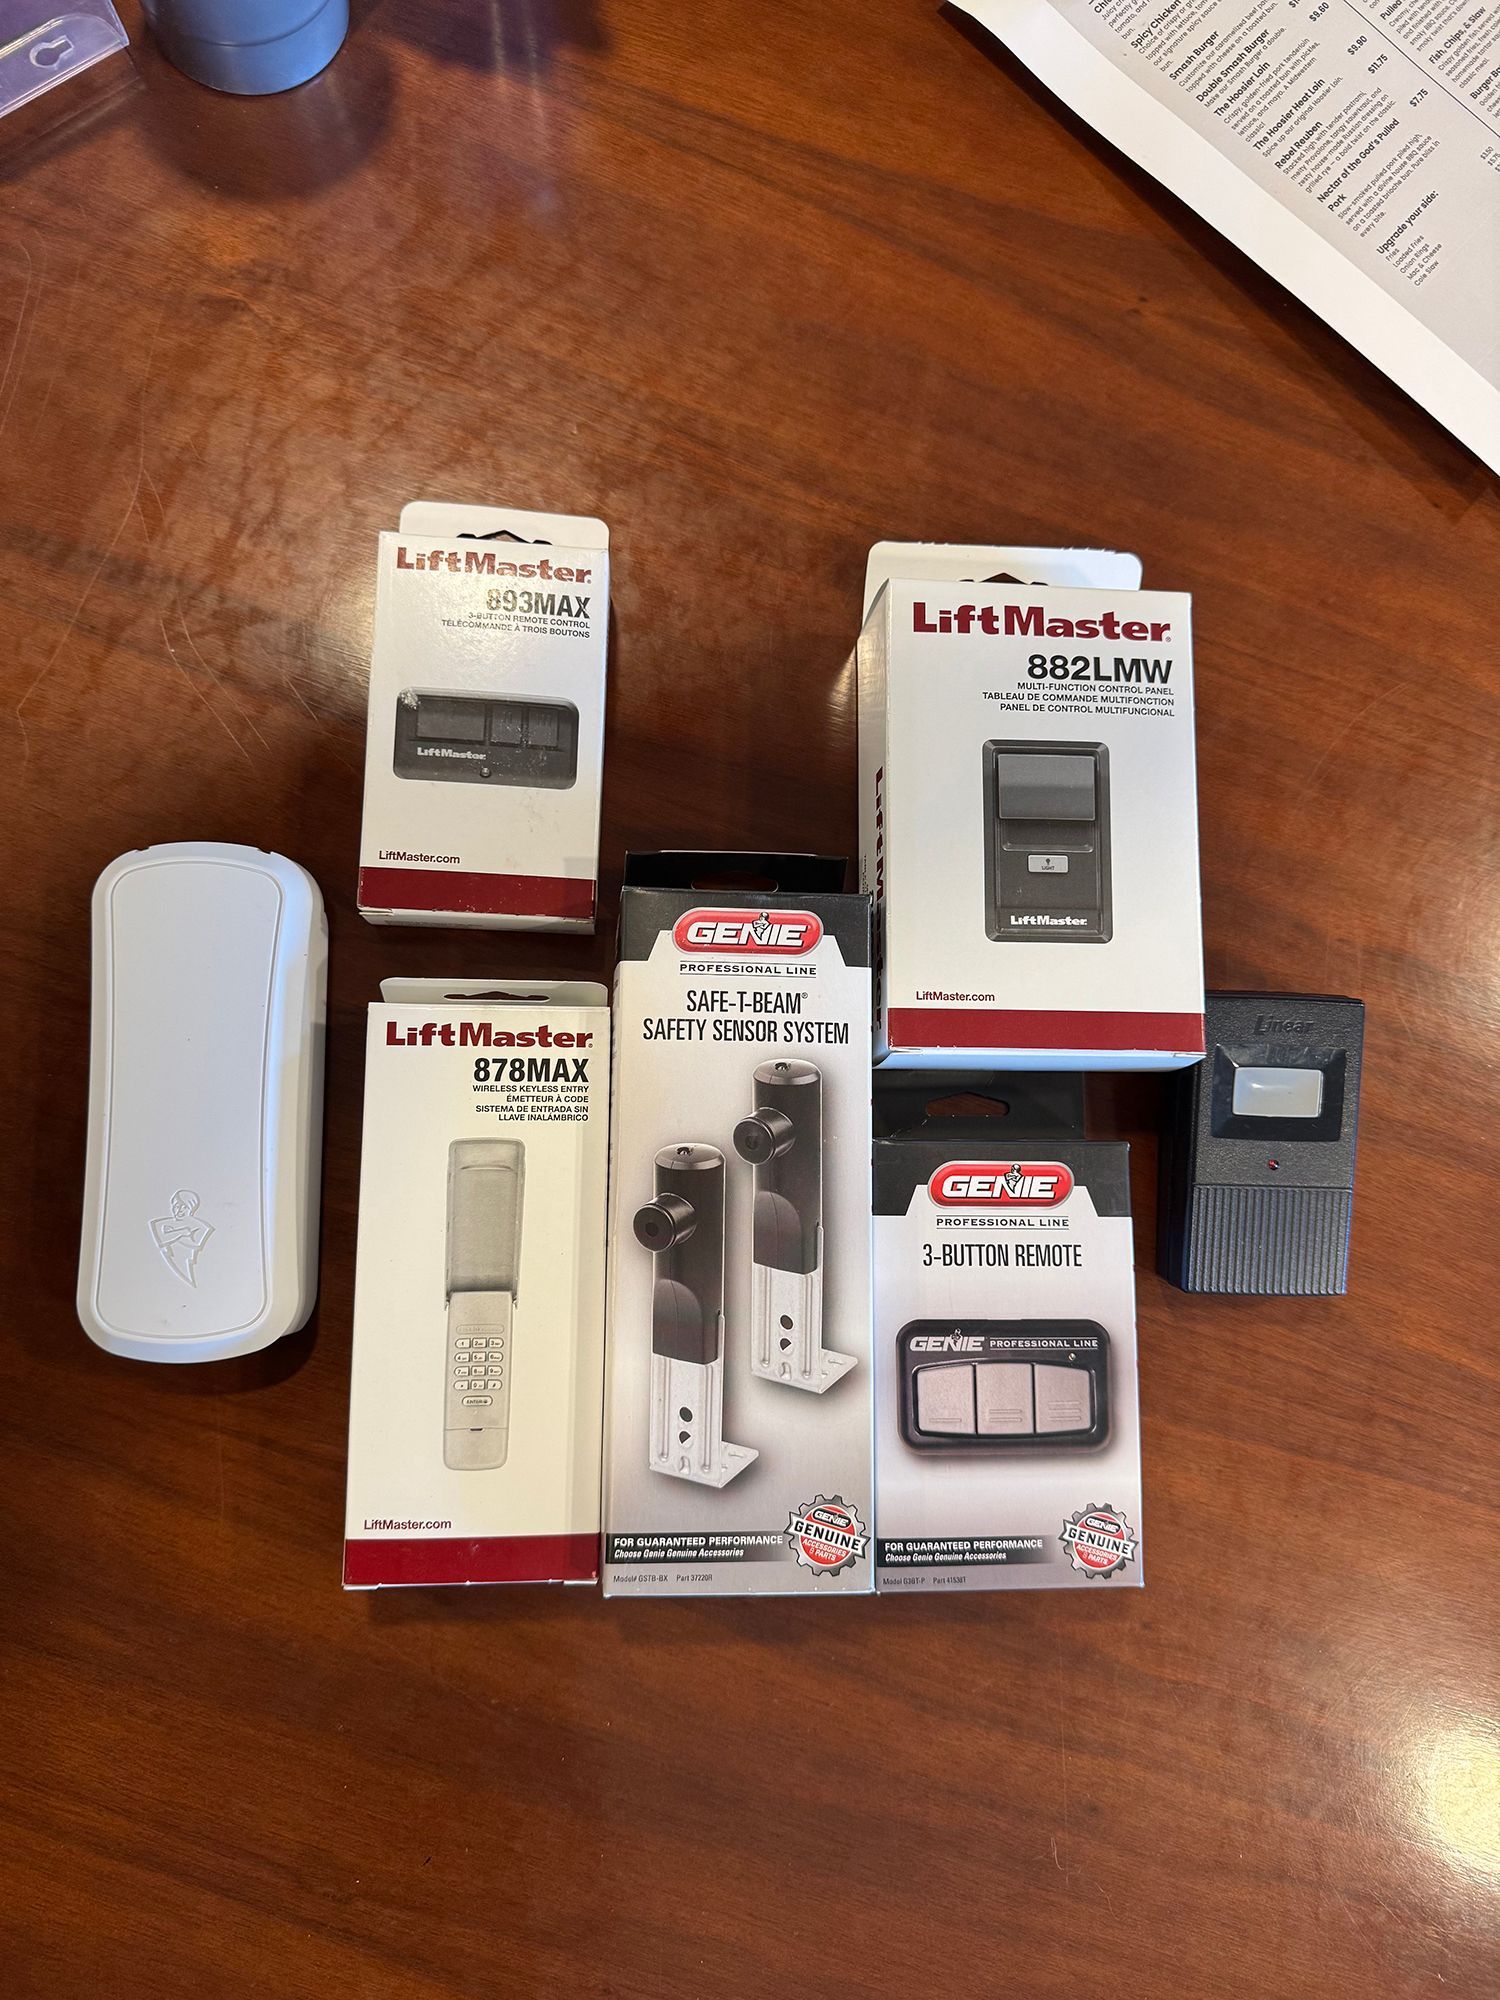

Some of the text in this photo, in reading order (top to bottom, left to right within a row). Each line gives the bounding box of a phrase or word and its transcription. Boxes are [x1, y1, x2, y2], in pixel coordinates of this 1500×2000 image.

[1308, 1, 1329, 21] $9.60
[1130, 0, 1181, 48] Spicy Chicken
[1428, 49, 1447, 64] Fish,
[1443, 29, 1466, 48] Chips,
[1467, 6, 1485, 23] Slaw
[1347, 35, 1367, 55] $9.90
[1169, 30, 1218, 80] Smash Burger
[1367, 53, 1387, 73] $11.75
[1195, 28, 1269, 102] Double Smash Burger
[1203, 93, 1220, 107] Make
[1218, 83, 1228, 94] our
[1226, 66, 1246, 85] Smash
[1243, 48, 1263, 67] Burger
[1266, 27, 1286, 45] double.
[1458, 57, 1489, 88] classic meal.
[1213, 62, 1270, 116] The Hoosier Loin
[1469, 75, 1493, 99] Burger
[1409, 88, 1428, 106] $7.75
[1252, 79, 1325, 149] The Hoosier Heat Loin
[1262, 76, 1343, 157] Spice up our original Hoosier Loin.
[1274, 121, 1322, 168] Rebel Reuben
[1316, 176, 1342, 202] Nectar
[1340, 167, 1350, 178] of
[1347, 158, 1361, 170] the
[1376, 117, 1399, 140] Pulled
[1327, 193, 1347, 211] Pork
[1376, 190, 1438, 253] Upgrade your side:
[1385, 247, 1399, 261] Fries
[1392, 235, 1424, 267] Loaded Fries
[1399, 243, 1429, 273] Onion Rings
[1406, 267, 1419, 280] Mac
[1421, 243, 1441, 263] Cheese
[1413, 260, 1439, 286] Cole Slaw
[486, 588, 590, 619] 893MAX
[513, 615, 548, 625] REMOTE
[550, 618, 590, 629] CONTROL
[522, 625, 548, 634] TROIS
[549, 628, 590, 638] BOUTONS
[1027, 655, 1172, 684] 882LMW
[1017, 682, 1174, 695] MULTI-FUNCTION CONTROL PANEL
[982, 692, 1174, 706] TABLEAU DE COMMANDE MULTIFONCTION
[1000, 703, 1174, 717] PANEL DE CONTROL MULTIFUNCIONAL
[417, 747, 486, 760] LiftMaster
[379, 850, 460, 864] LiftMaster.com
[1010, 915, 1087, 927] LiftMaster
[686, 922, 808, 947] GENIE
[680, 964, 816, 975] PROFESSIONAL LINE
[916, 991, 995, 1001] LiftMaster.com
[643, 1018, 848, 1044] SAFETY SENSOR SYSTEM
[1254, 1014, 1314, 1035] Linear
[474, 1058, 589, 1083] 878MAX
[506, 1094, 589, 1103] ÉMETTEUR À CODE
[519, 1085, 559, 1093] KEYLESS
[561, 1085, 589, 1093] ENTRY
[527, 1113, 589, 1121] INALÁMBRICO
[531, 1105, 572, 1113] ENTRADA
[574, 1105, 589, 1113] SIN
[942, 1175, 1059, 1199] GENIE
[937, 1218, 1069, 1227] PROFESSIONAL LINE
[923, 1244, 1082, 1267] 3-BUTTON REMOTE
[910, 1336, 985, 1351] GENIE
[364, 1519, 451, 1530] LiftMaster.com
[813, 1510, 850, 1528] GENIE
[1086, 1517, 1119, 1533] GENIE
[614, 1536, 783, 1547] FOR GUARANTEED PERFORMANCE
[794, 1520, 862, 1551] GENUINE
[1068, 1527, 1130, 1554] GENUINE
[614, 1548, 744, 1558] Choose Genie Genuine Accessories
[802, 1538, 847, 1557] ACCESSORIES
[815, 1548, 837, 1561] PARTS
[885, 1539, 1042, 1552] FOR GUARANTEED PERFORMANCE
[1076, 1543, 1118, 1561] ACCESSORIES
[885, 1551, 1006, 1562] Choose Genie Genuine Accessories
[1088, 1553, 1108, 1565] PARTS
[613, 1575, 637, 1583] Model#
[638, 1574, 668, 1582] GSTB-BX
[676, 1574, 689, 1582] Part
